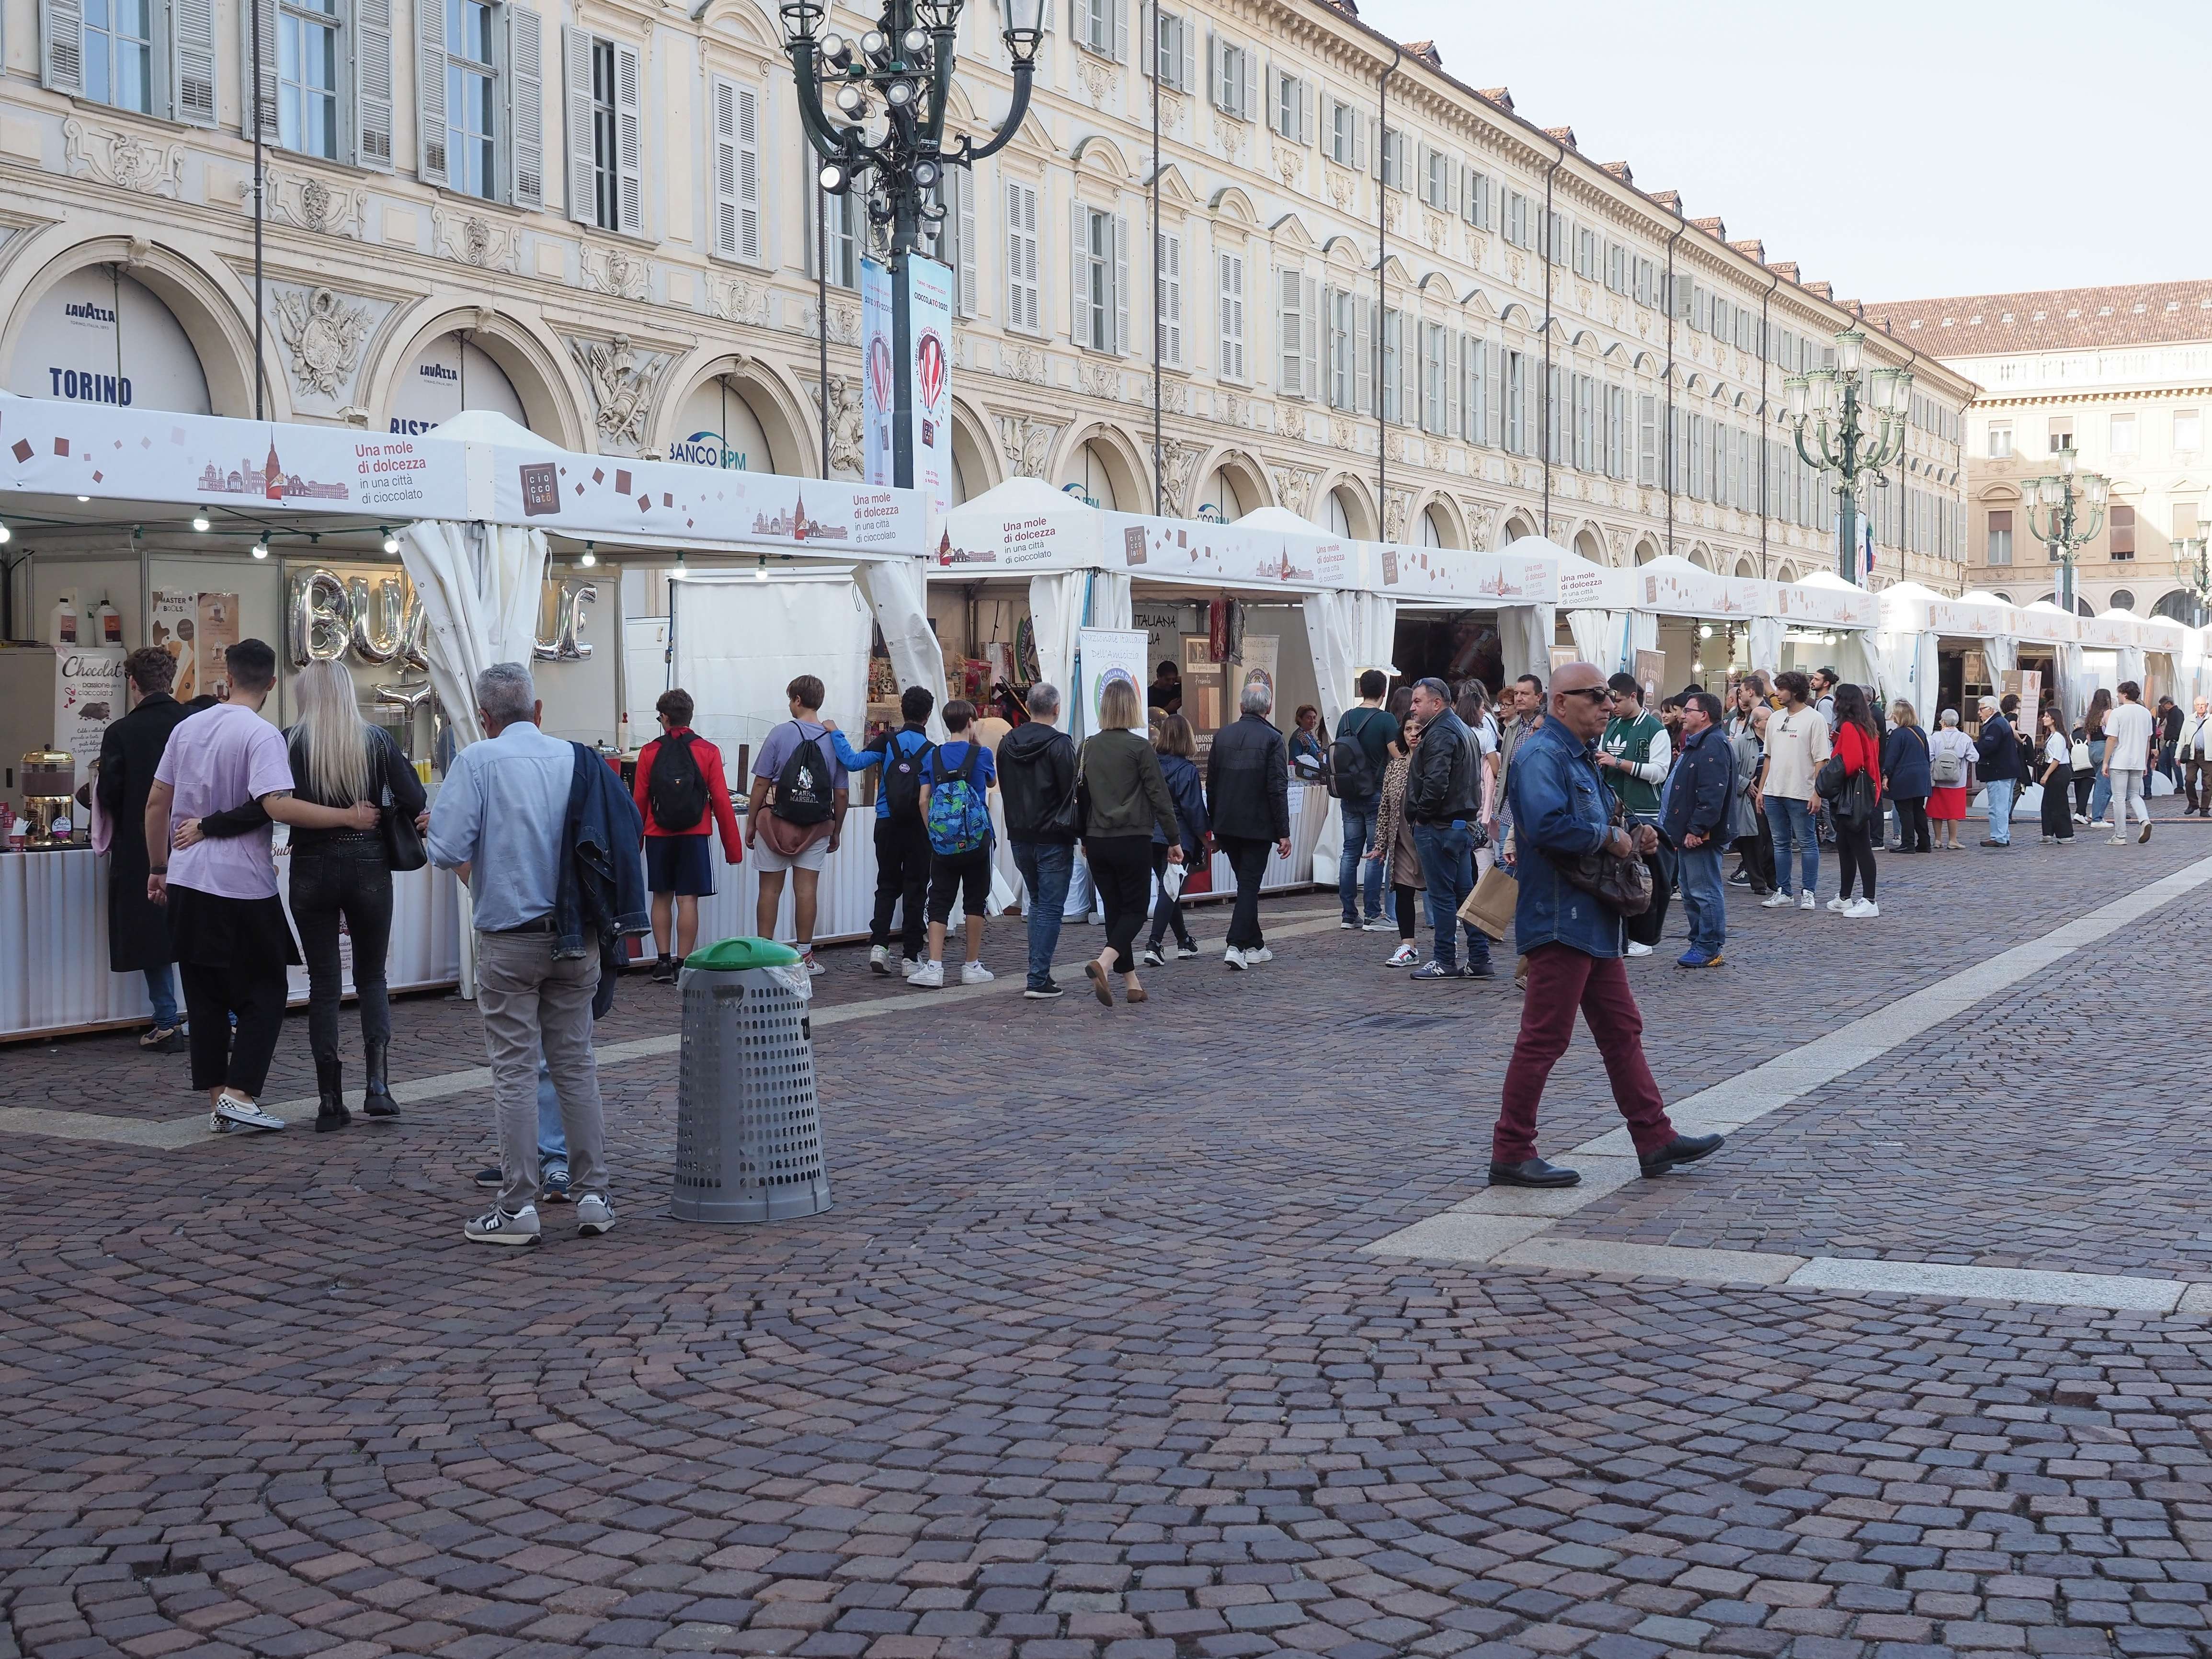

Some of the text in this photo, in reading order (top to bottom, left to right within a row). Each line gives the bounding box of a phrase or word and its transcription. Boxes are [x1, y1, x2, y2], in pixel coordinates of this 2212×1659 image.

[65, 302, 115, 323] LAVAZZA
[938, 301, 948, 311] 2022
[420, 363, 458, 381] LAVAZZA
[49, 367, 132, 406] TORINO
[390, 417, 439, 436] RIST
[355, 441, 413, 458] Una mole
[669, 442, 746, 470] BANCO BPM
[358, 458, 426, 474] di dolcezza
[360, 473, 413, 489] in una città
[362, 489, 423, 504] di cioccolato
[853, 492, 891, 505] Una mole
[855, 506, 899, 519] di dolcezza
[855, 518, 889, 531] in una città
[1003, 517, 1047, 532] Una mole
[856, 531, 896, 543] di cioccolato
[1004, 528, 1055, 543] di dolcezza
[1028, 539, 1044, 550] città
[1316, 543, 1340, 554] Una mole
[1005, 550, 1051, 564] di cioccolato
[1317, 554, 1345, 564] di dolcezza
[1577, 572, 1595, 580] mole
[1570, 580, 1602, 589] dolcezza
[1569, 595, 1599, 604] cioccolato
[1134, 614, 1176, 629] ITALIANA
[1082, 632, 1147, 644] Nazionale Italiana
[1103, 670, 1124, 684] ITALIANA
[1194, 734, 1214, 743] ABOSSE
